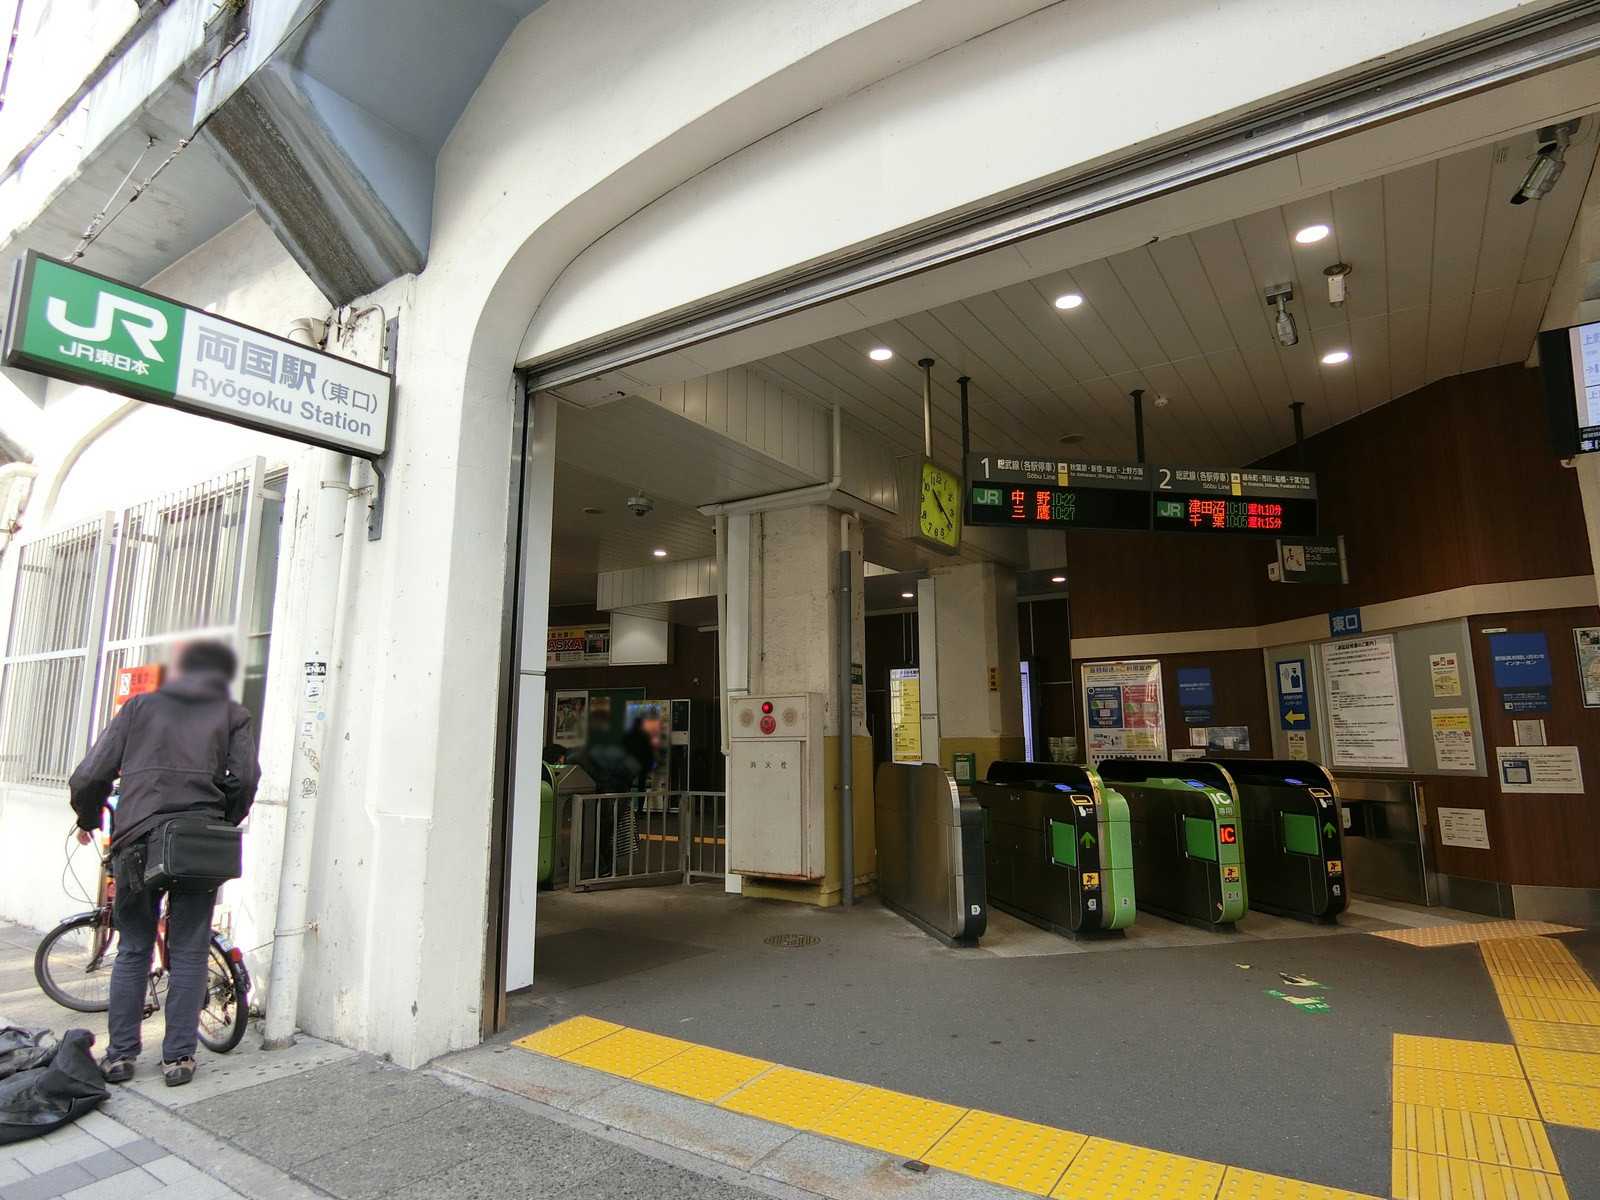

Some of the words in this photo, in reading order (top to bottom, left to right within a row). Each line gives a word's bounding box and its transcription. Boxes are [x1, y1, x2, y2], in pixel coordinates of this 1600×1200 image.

[45, 290, 168, 363] JR
[58, 340, 150, 376] JR東日本
[191, 368, 293, 415] Ryōgoku
[300, 402, 371, 437] Station
[980, 457, 990, 479] 1
[1159, 468, 1172, 489] 2
[977, 489, 999, 504] JR
[1051, 492, 1076, 507] 10:22
[1051, 506, 1076, 521] 10:27
[1160, 503, 1181, 517] JR
[1188, 500, 1226, 515] 津田沼
[1226, 502, 1248, 515] 10:10
[1226, 515, 1248, 528] 10:05
[1332, 614, 1358, 632] 東口
[1210, 792, 1231, 805] IC
[1220, 827, 1235, 843] IC
